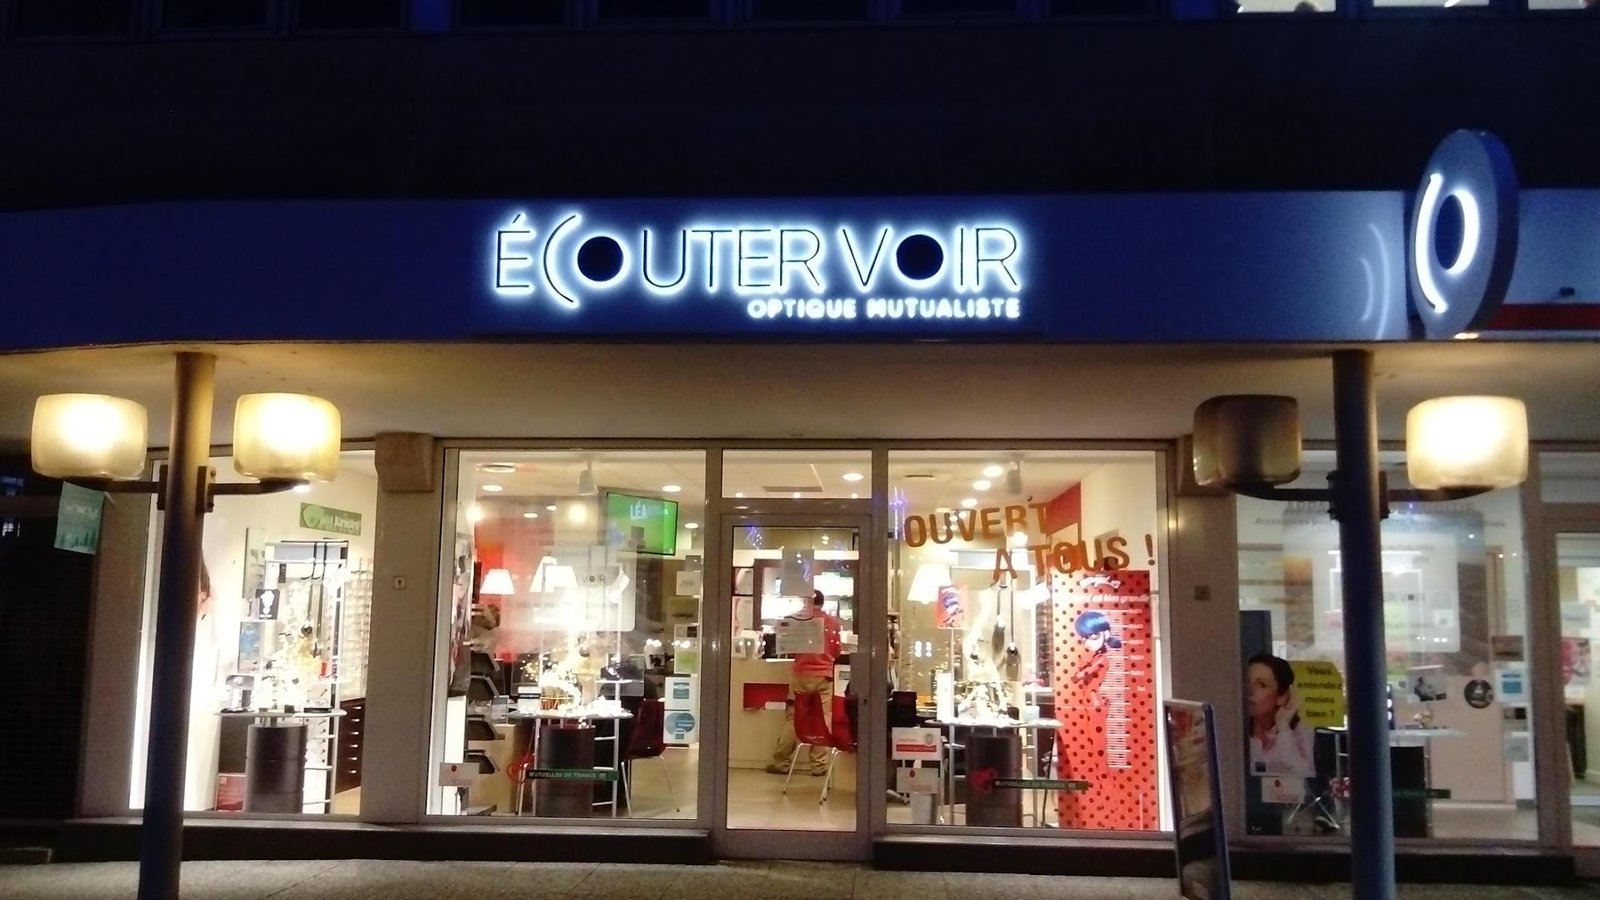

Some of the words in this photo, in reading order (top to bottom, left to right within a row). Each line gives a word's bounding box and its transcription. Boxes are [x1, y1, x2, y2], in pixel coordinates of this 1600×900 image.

[495, 211, 822, 305] ÉCOUTER
[840, 225, 1020, 290] VOIR
[747, 297, 857, 319] OPTIQUE
[867, 297, 1020, 319] MUTUALISTE
[903, 503, 1050, 548] OUVERT
[992, 546, 1018, 583] A
[1026, 536, 1131, 578] TOUS
[1145, 533, 1156, 567] !
[1306, 666, 1332, 675] Vous
[1297, 682, 1342, 690] entendez
[1305, 696, 1335, 704] moins
[1306, 710, 1327, 718] bien
